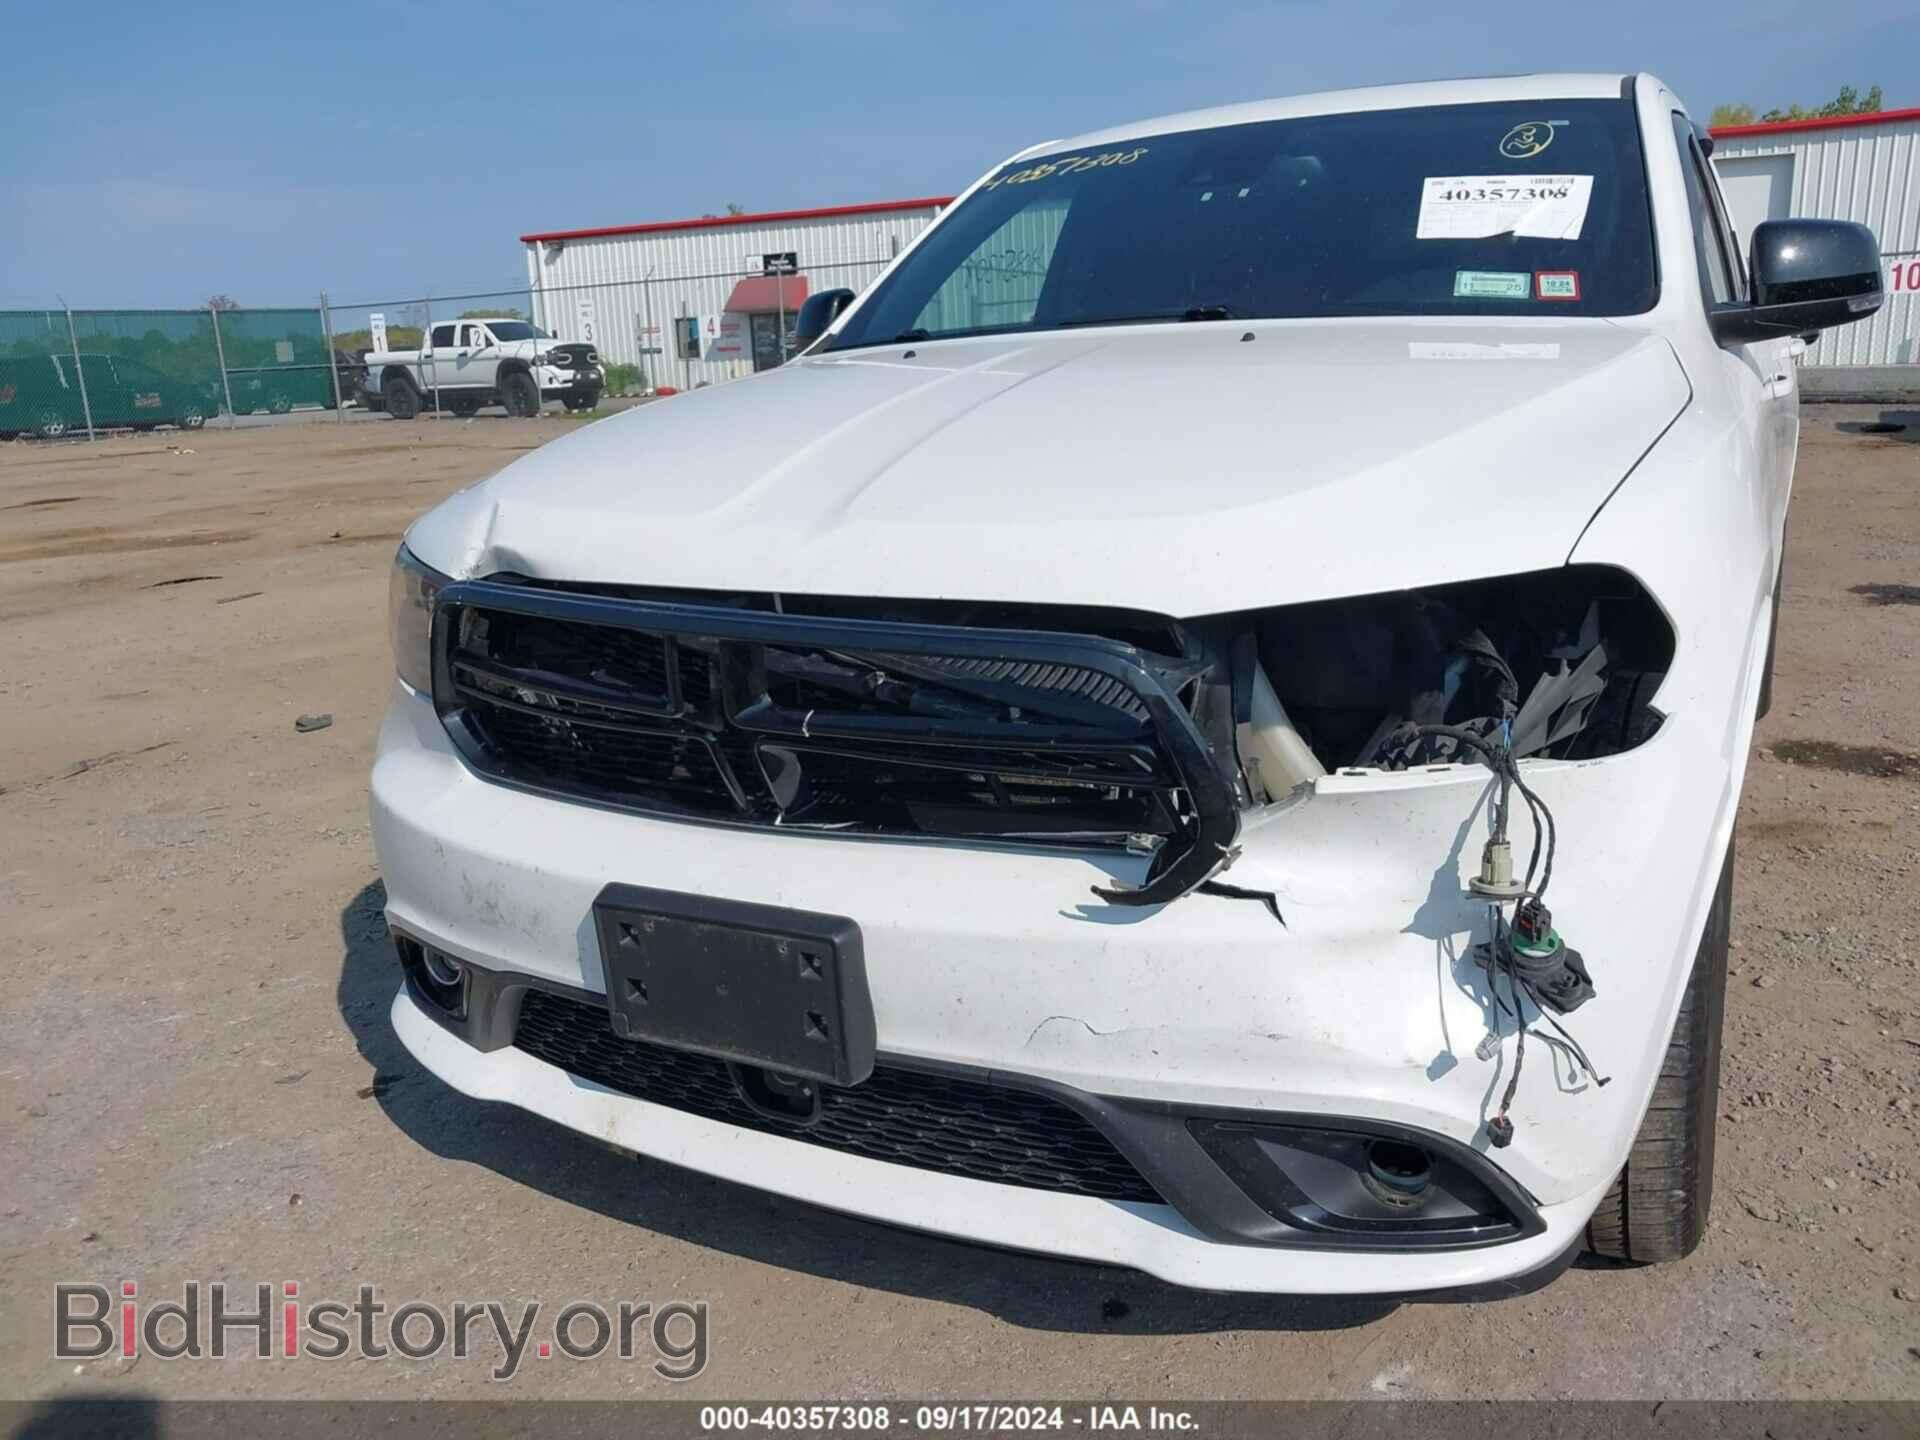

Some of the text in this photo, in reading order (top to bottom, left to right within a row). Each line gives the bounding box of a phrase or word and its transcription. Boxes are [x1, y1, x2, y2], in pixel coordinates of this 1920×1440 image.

[1439, 187, 1569, 202] 40357308
[585, 323, 593, 341] 3
[707, 317, 715, 336] 4
[377, 336, 384, 352] 1
[473, 330, 481, 347] 2
